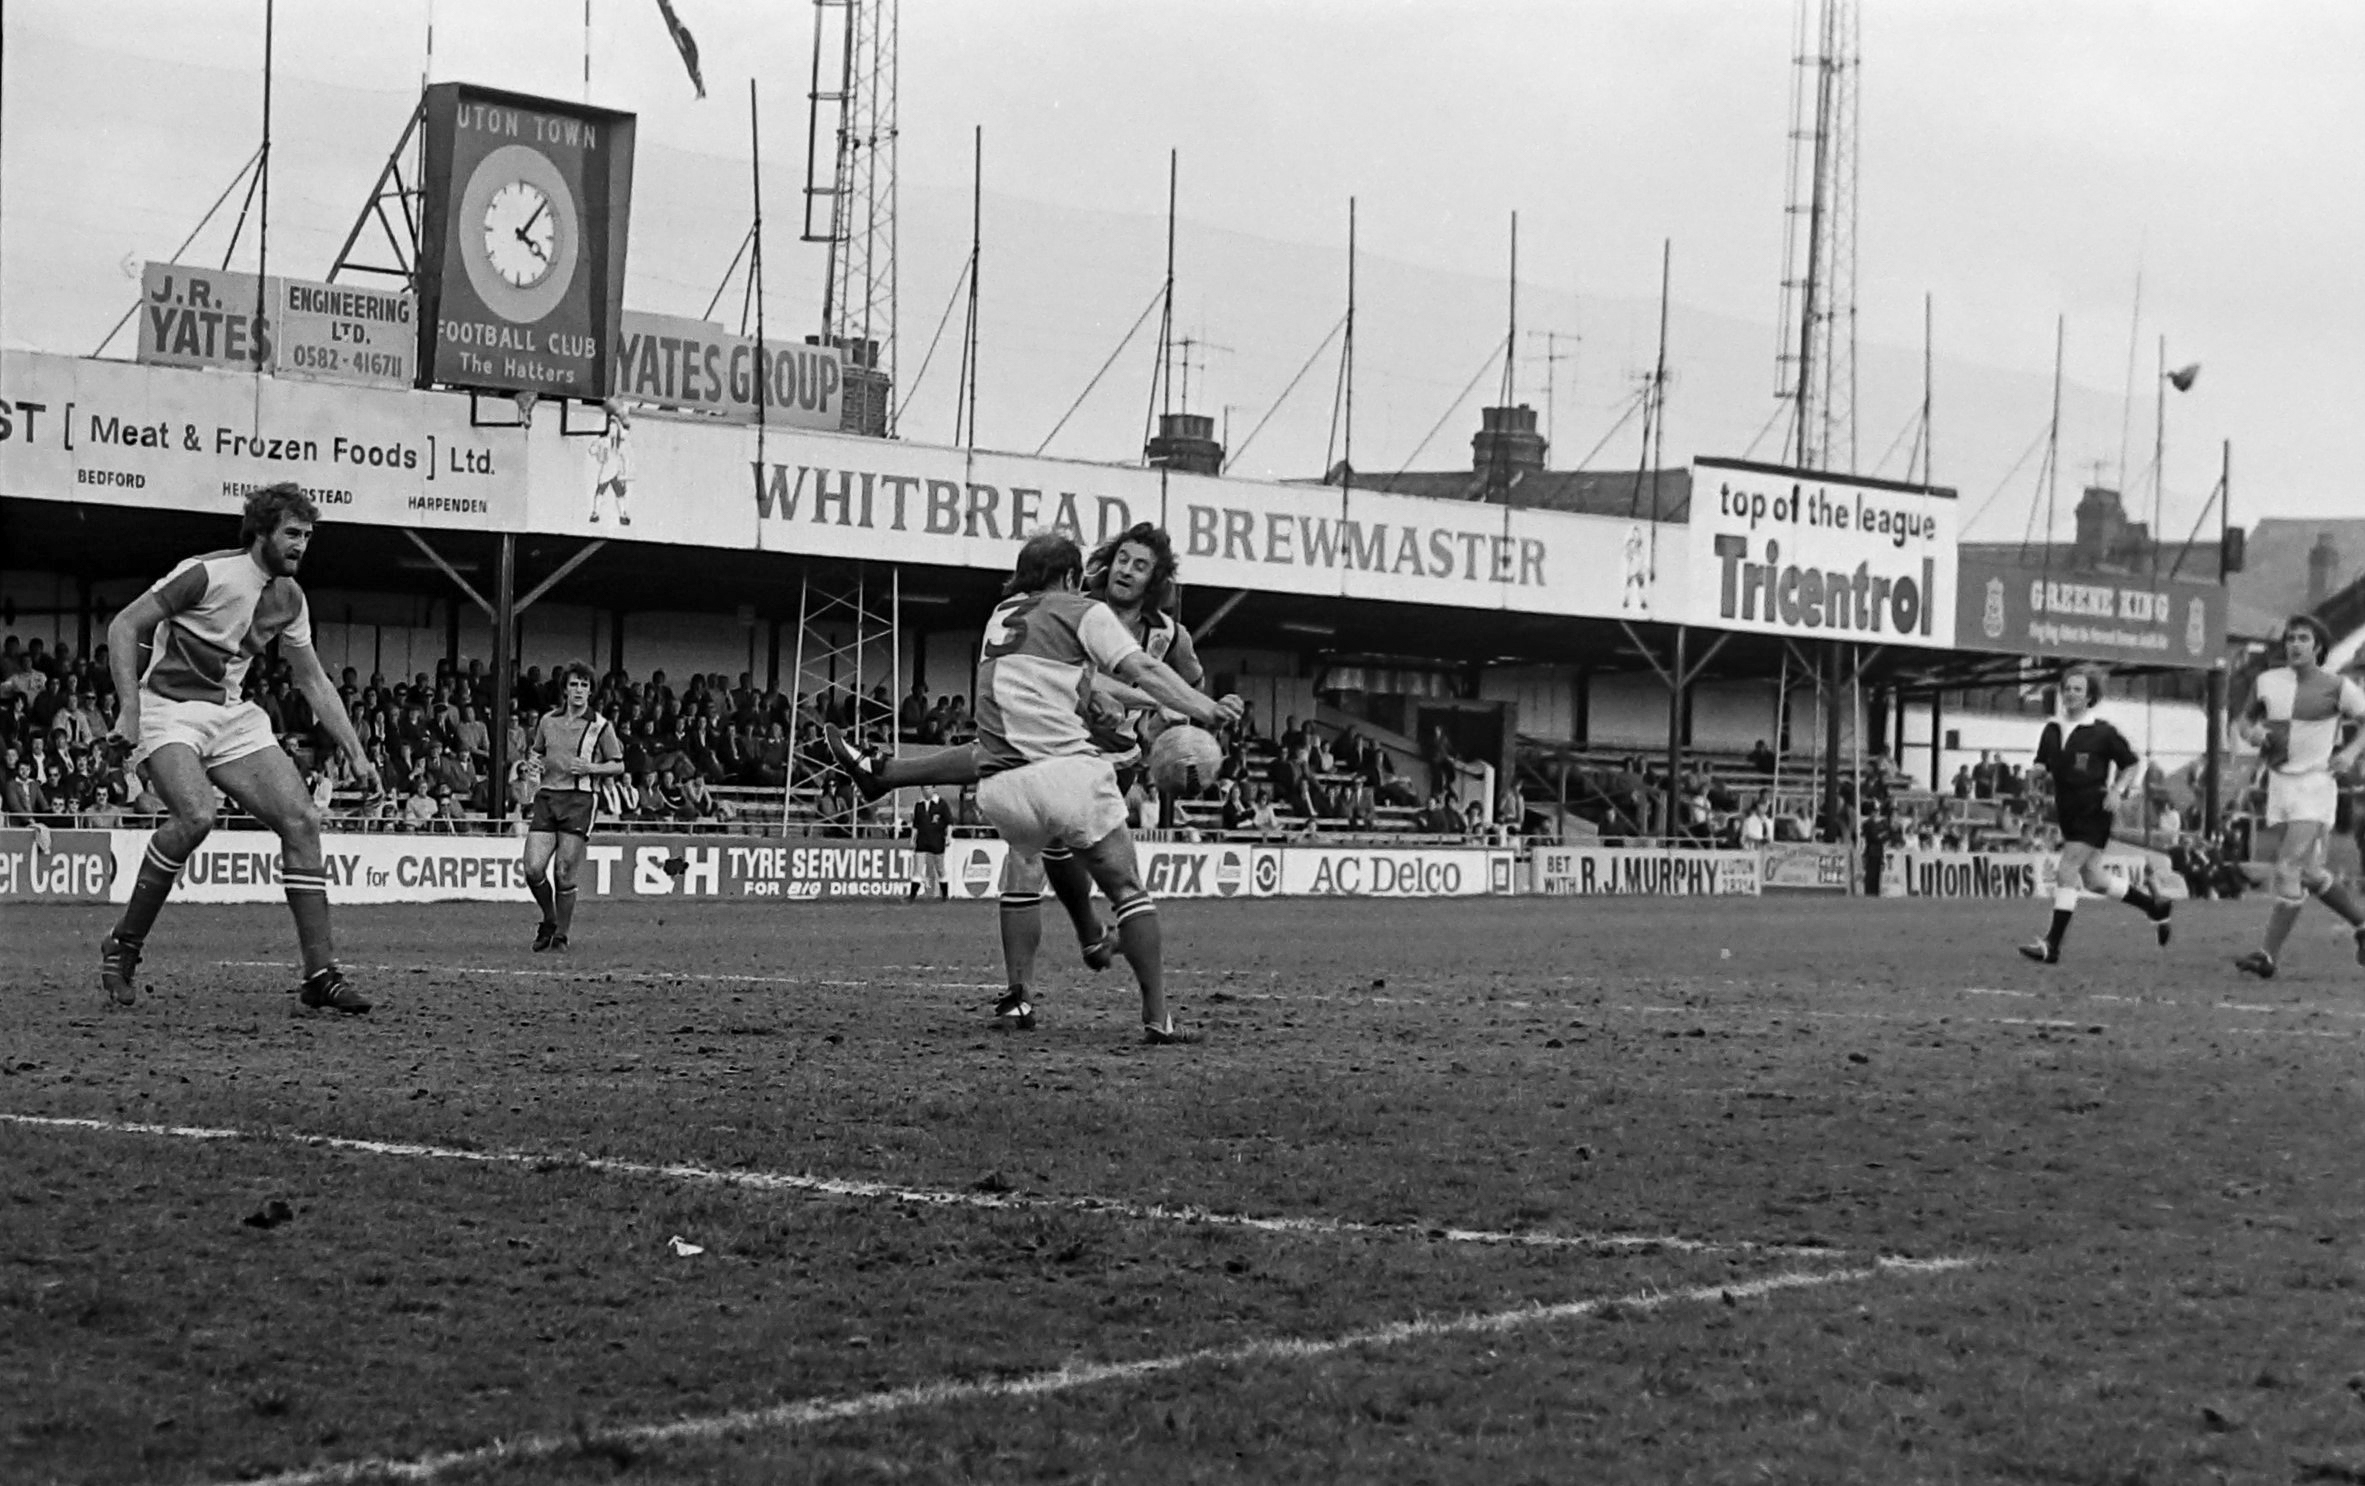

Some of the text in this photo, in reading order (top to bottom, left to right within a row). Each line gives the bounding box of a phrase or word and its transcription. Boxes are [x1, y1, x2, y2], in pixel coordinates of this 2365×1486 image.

[533, 115, 596, 149] TOWN
[151, 275, 222, 309] J.R.
[289, 285, 409, 323] ENGINEERING
[150, 305, 272, 363] YATES
[331, 321, 371, 345] LTD.
[548, 332, 596, 359] CLUB
[459, 351, 575, 384] The Hatters
[616, 331, 839, 413] YATES GROUP
[91, 414, 169, 450] Meat
[183, 424, 202, 452] &
[215, 427, 317, 461] Frozen
[333, 436, 418, 469] Foods
[450, 446, 495, 476] Ltd.
[78, 468, 146, 489] BEDFORD
[408, 494, 488, 514] HARPENDEN
[1720, 481, 1937, 548] top of the league
[750, 461, 1547, 587] WHITBREAD BREWMASTER
[1713, 532, 1935, 638] Tricentrol
[30, 841, 104, 896] Care
[366, 865, 390, 888] for
[396, 855, 528, 889] CARPETS
[727, 847, 786, 880] TYRE
[791, 847, 884, 880] SERVICE
[1145, 852, 1209, 894] GTX
[1309, 855, 1361, 894] AC
[1368, 856, 1462, 894] Delco
[1547, 855, 1572, 873] BET
[744, 881, 780, 896] FOR
[786, 880, 822, 897] BIG
[1544, 876, 1577, 894] WITH
